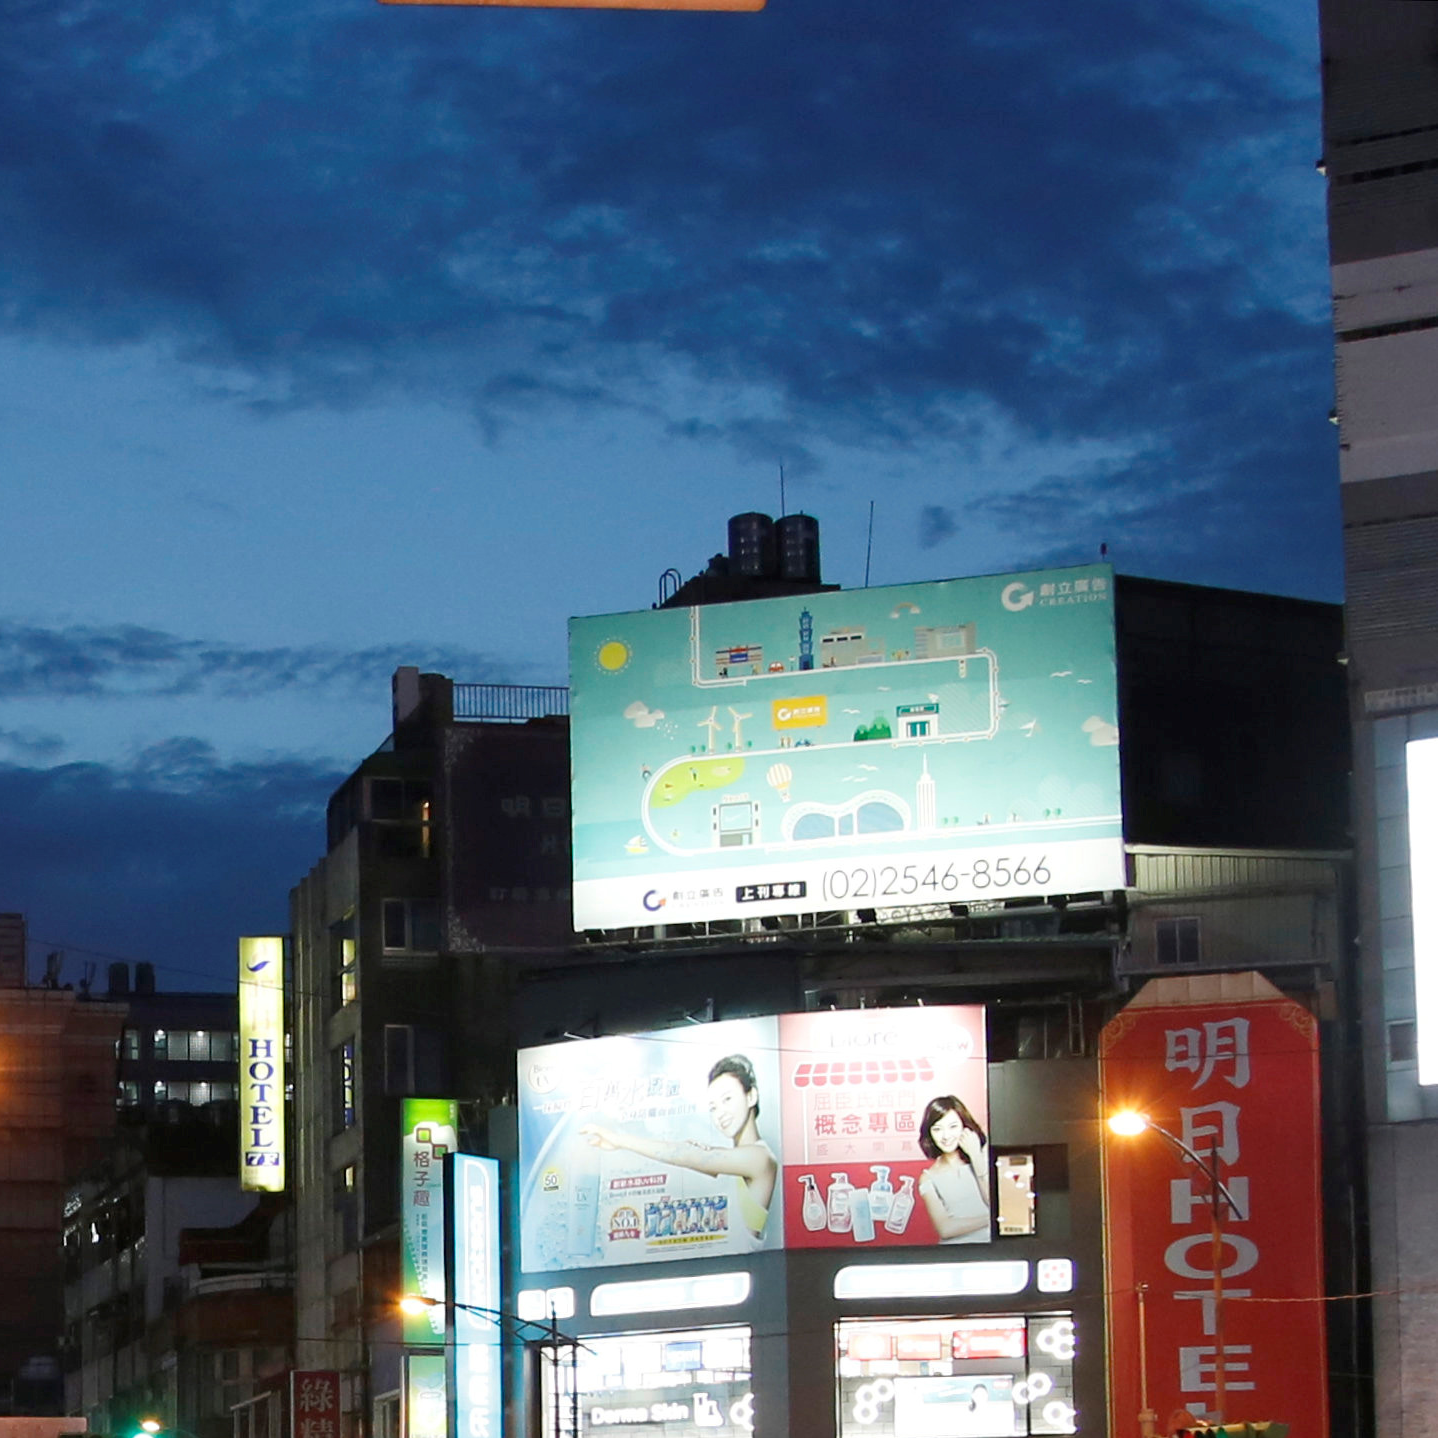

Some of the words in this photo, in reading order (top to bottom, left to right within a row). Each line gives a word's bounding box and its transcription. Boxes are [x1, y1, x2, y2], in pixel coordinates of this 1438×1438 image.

[822, 855, 1052, 900] (02)2546-8566
[247, 1038, 275, 1148] HOTEL
[814, 1111, 916, 1137] 概念專區
[246, 1152, 280, 1167] 7F
[412, 1150, 431, 1208] 格子趣
[650, 1401, 690, 1421] Skin
